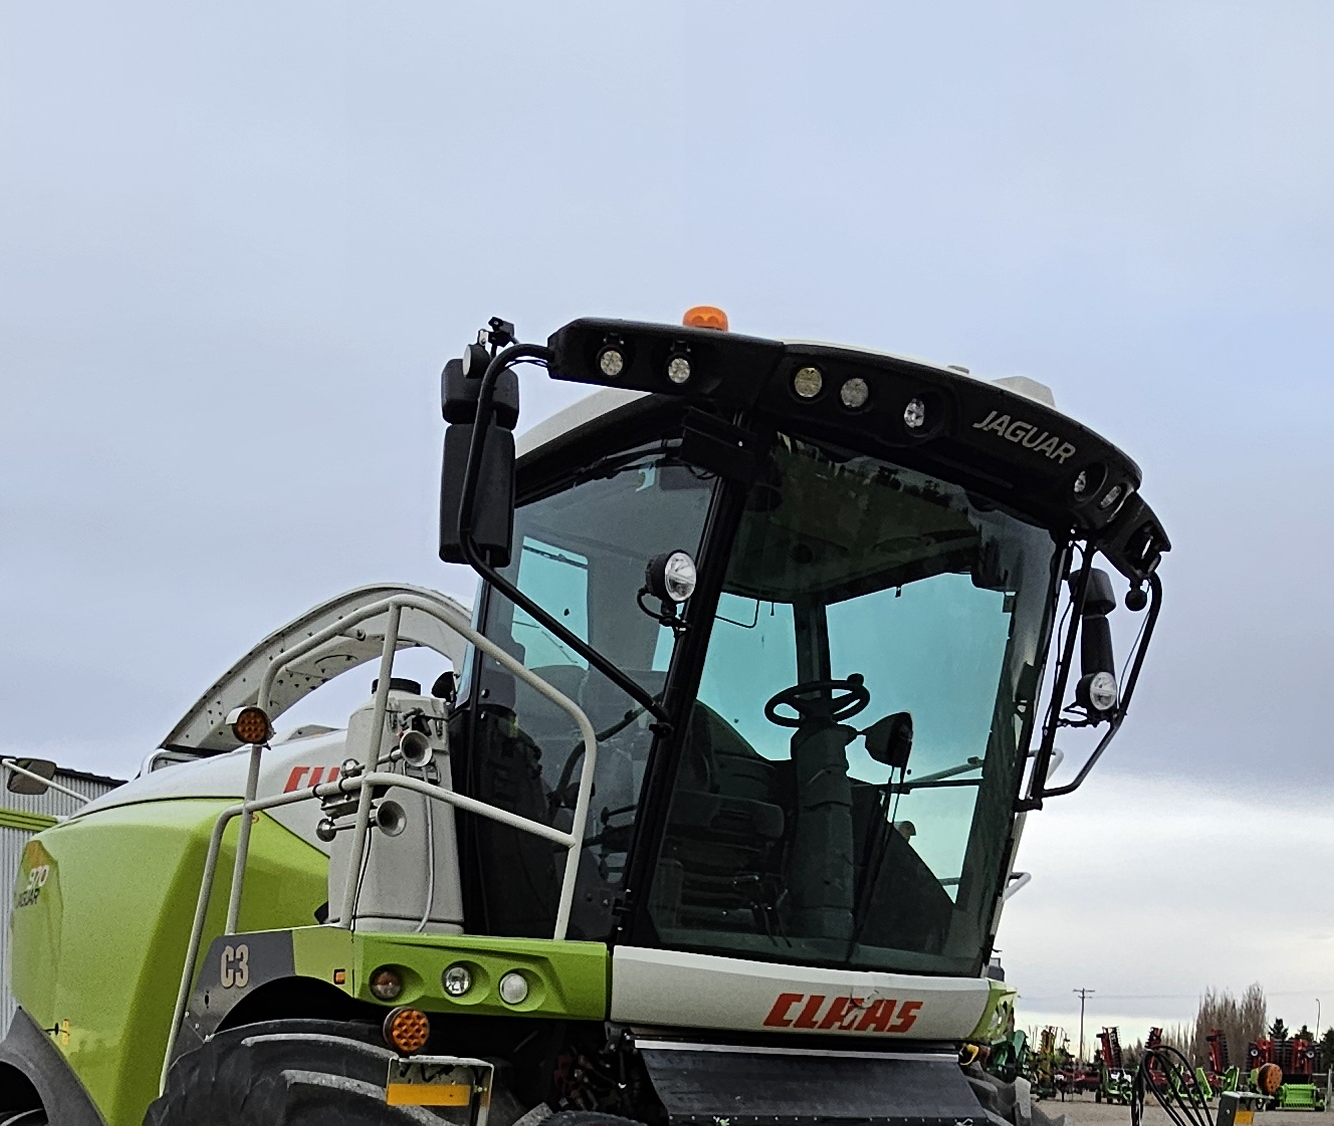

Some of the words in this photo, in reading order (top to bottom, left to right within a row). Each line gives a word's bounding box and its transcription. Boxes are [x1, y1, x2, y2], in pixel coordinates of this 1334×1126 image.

[972, 409, 1076, 465] JAGUAR
[220, 943, 250, 989] C3
[763, 992, 924, 1034] CLAAS
